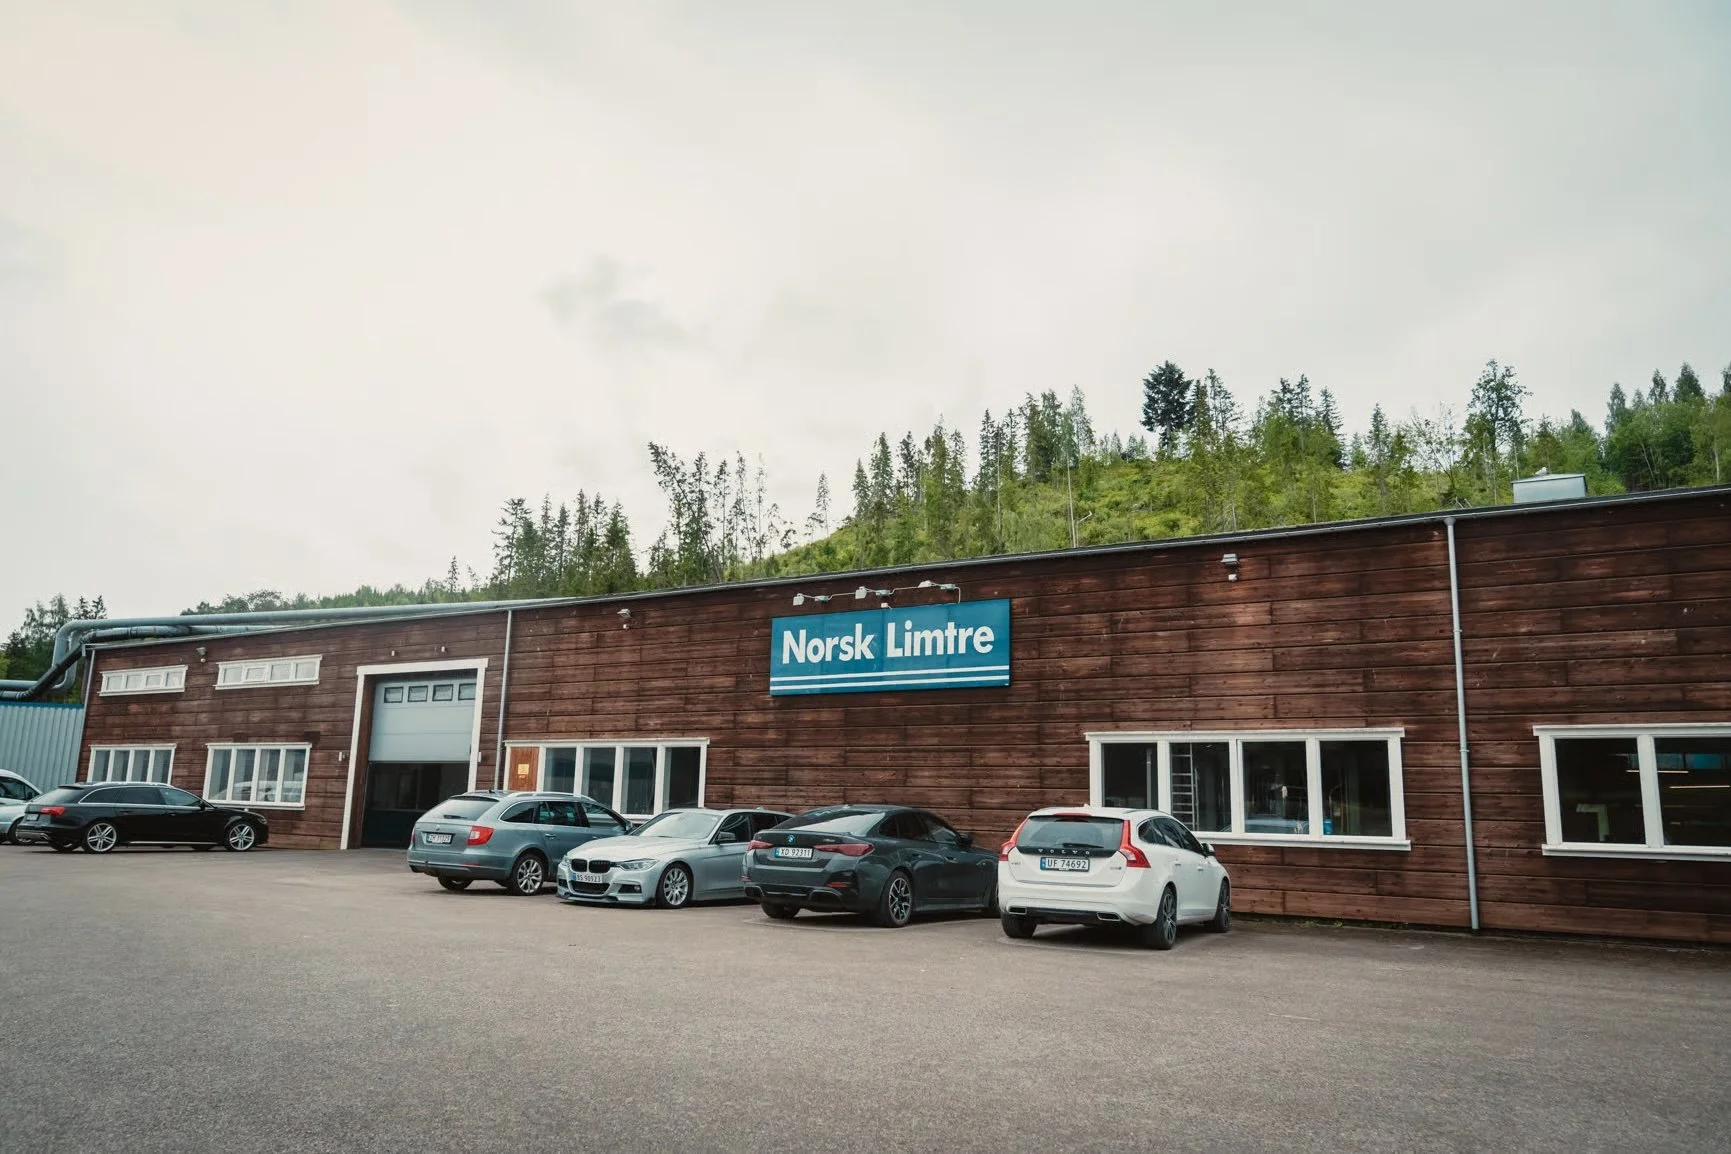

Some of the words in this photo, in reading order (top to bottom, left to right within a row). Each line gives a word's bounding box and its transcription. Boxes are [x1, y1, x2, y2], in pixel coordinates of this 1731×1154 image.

[782, 623, 875, 664] Norsk
[887, 620, 994, 657] Limtre
[1047, 859, 1058, 867] UF
[1061, 859, 1087, 869] 74692
